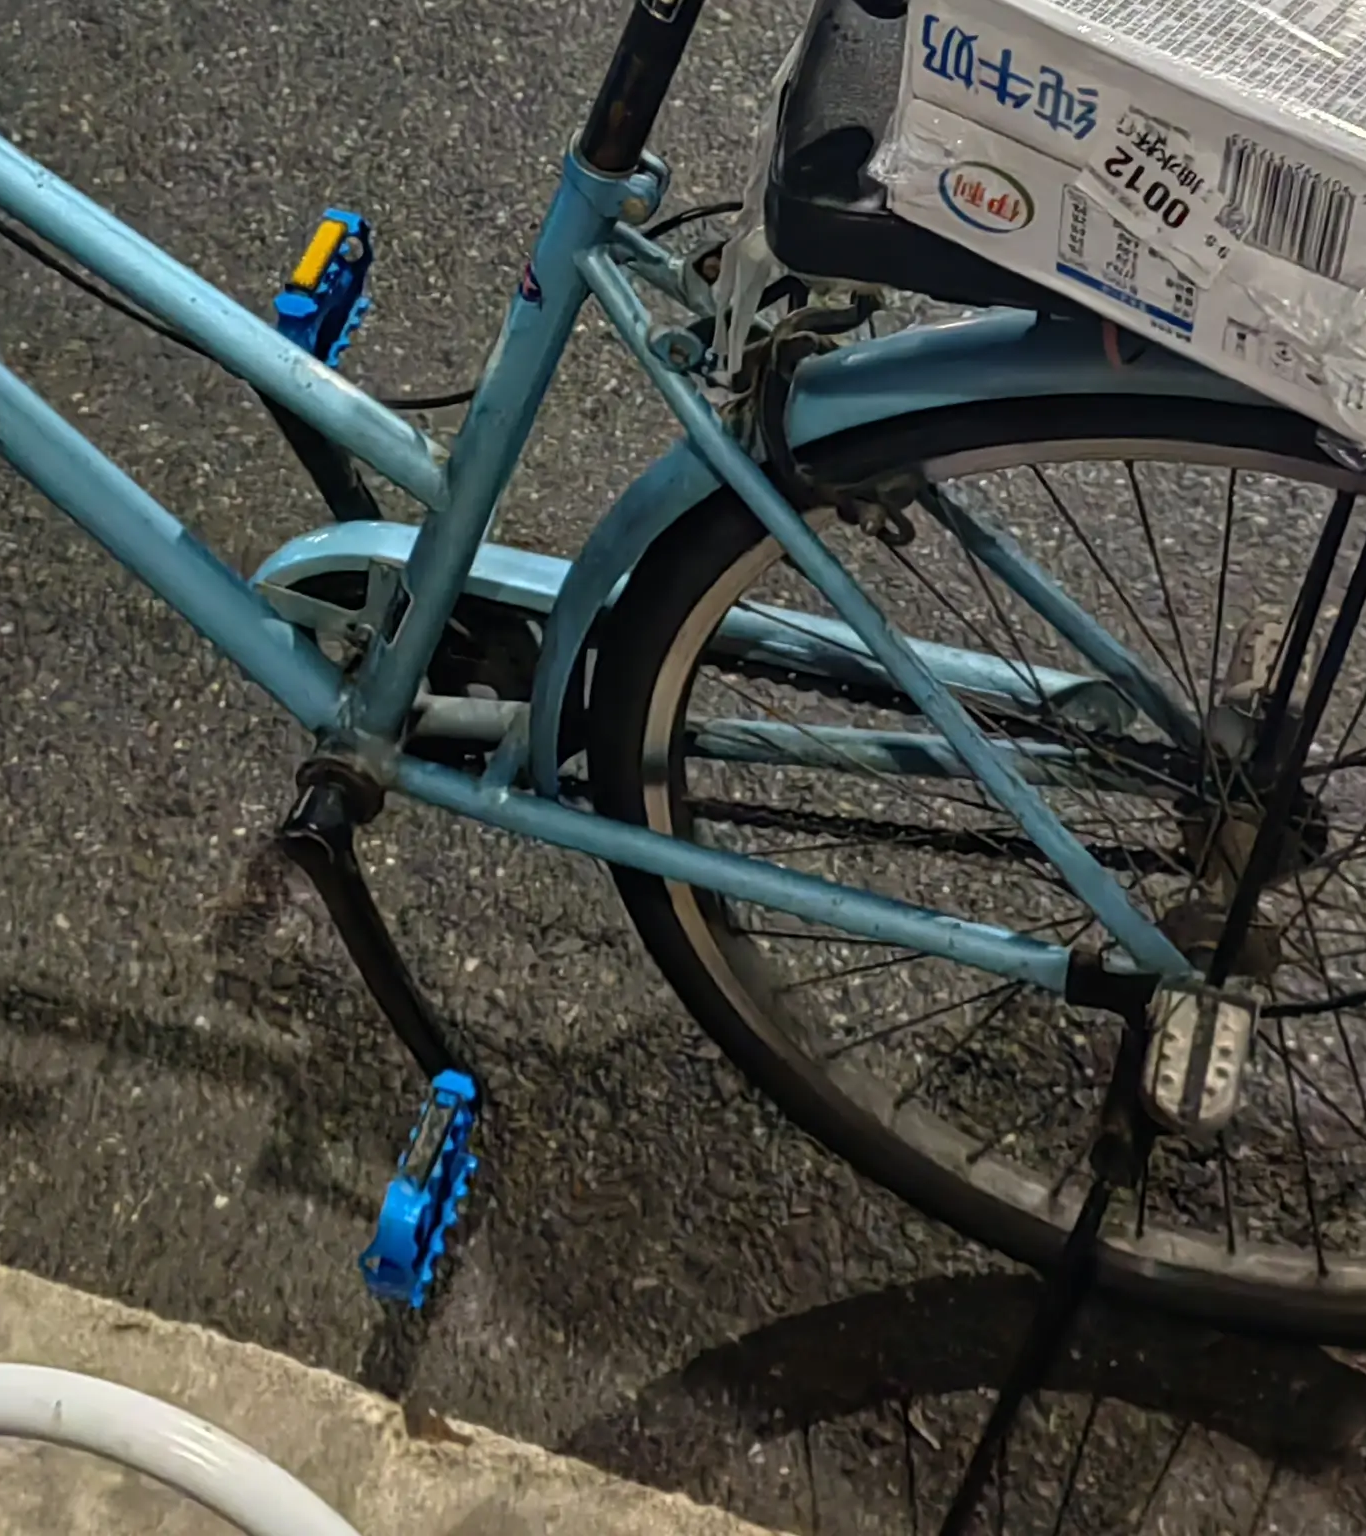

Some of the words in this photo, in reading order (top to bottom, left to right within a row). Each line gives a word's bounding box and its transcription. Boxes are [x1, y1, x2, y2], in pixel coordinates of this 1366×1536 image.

[922, 15, 1099, 140] 纯牛奶
[953, 174, 1020, 223] 伊利
[1104, 145, 1191, 229] 0012
